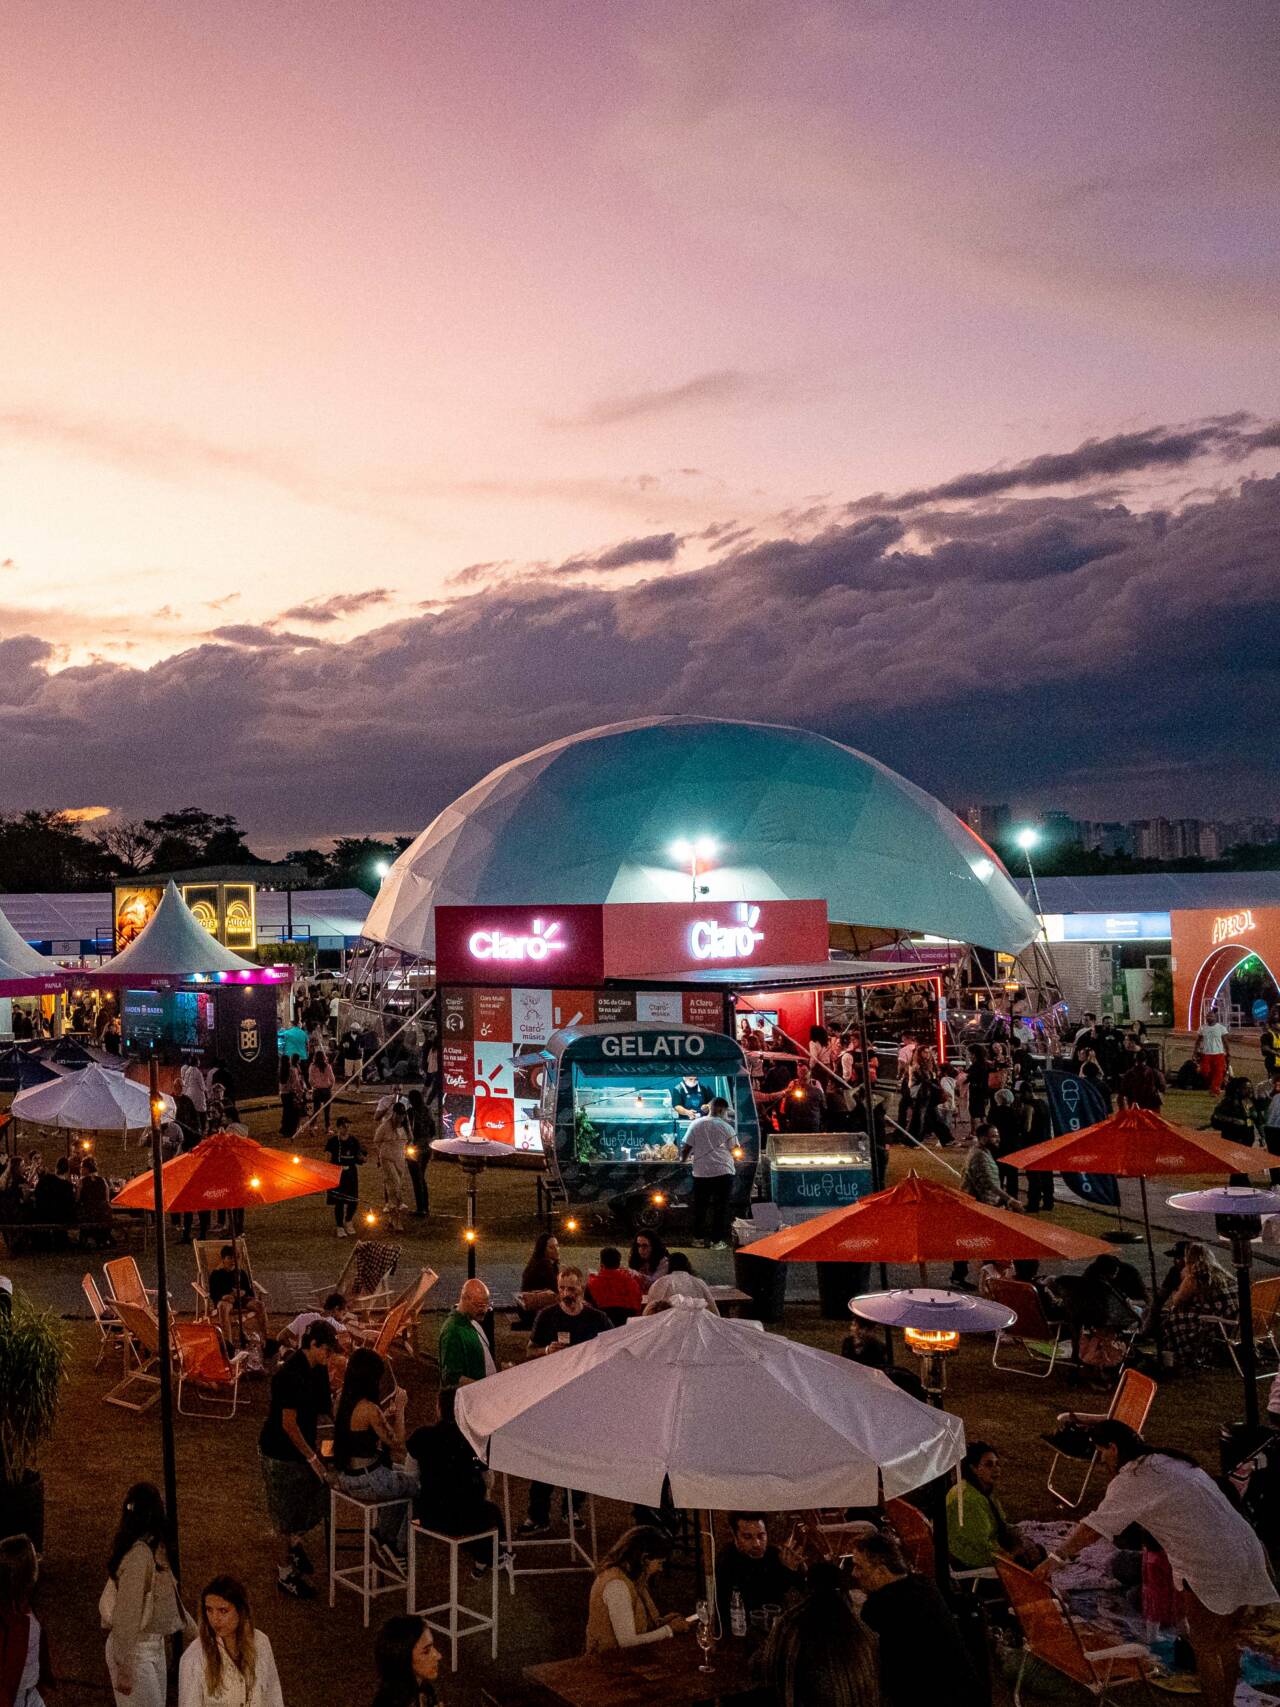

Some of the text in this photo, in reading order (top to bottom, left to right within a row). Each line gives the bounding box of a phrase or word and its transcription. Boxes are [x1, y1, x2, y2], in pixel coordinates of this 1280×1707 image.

[690, 920, 754, 959] Claro
[1212, 909, 1256, 944] APEROL
[469, 931, 549, 960] Claro
[520, 1024, 540, 1032] Claro
[602, 1035, 705, 1056] GELATO
[797, 1173, 858, 1197] due due
